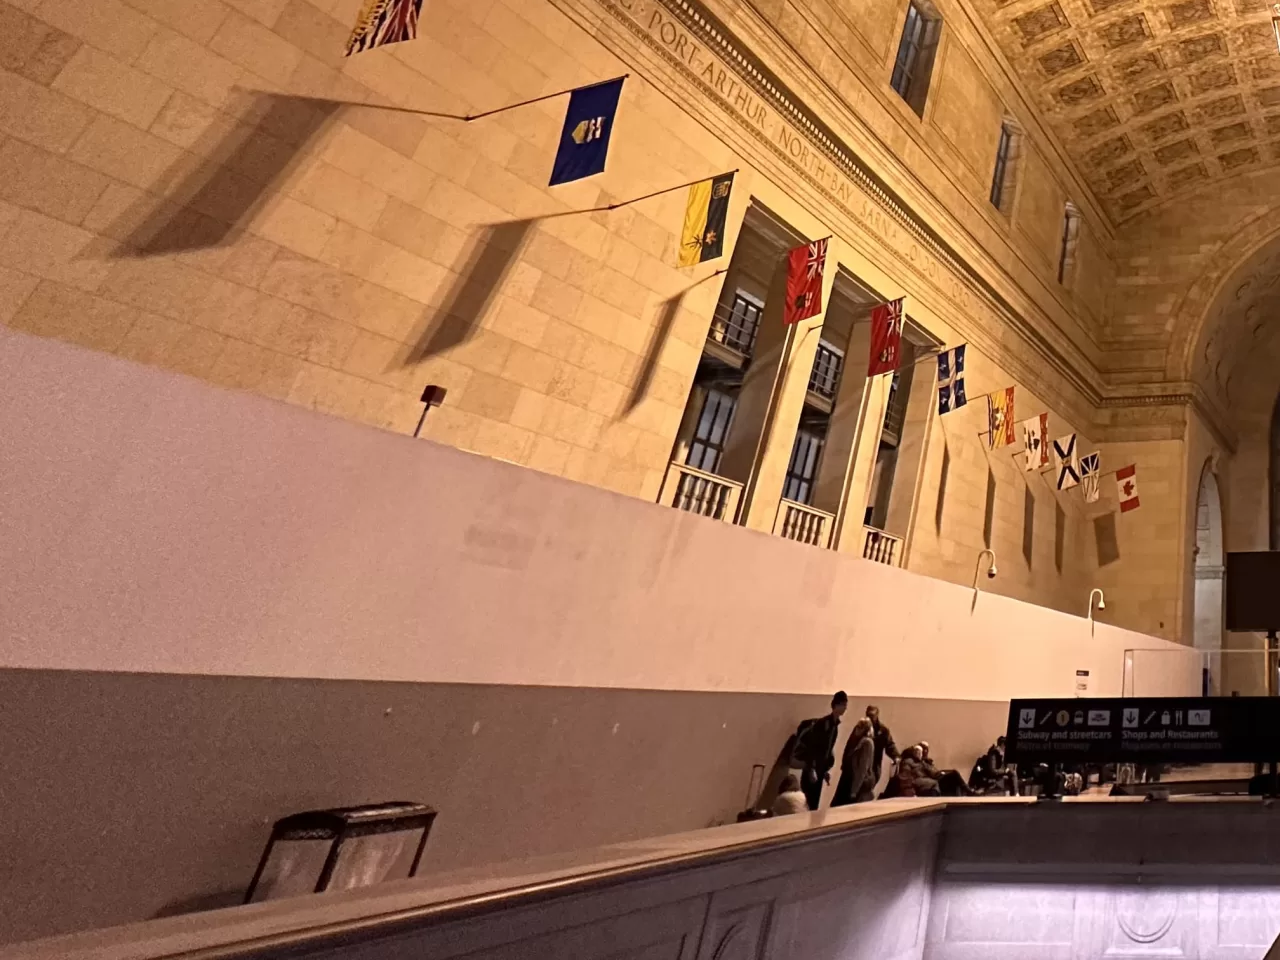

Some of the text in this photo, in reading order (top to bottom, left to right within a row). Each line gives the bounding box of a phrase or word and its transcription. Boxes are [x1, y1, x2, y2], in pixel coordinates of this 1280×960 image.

[648, 10, 768, 128] PORT-ARTHUR
[778, 126, 854, 204] NORTH-BAY
[859, 198, 898, 242] SARNA
[1016, 730, 1112, 742] Subway and streetcars
[1121, 728, 1219, 742] Shops and Restaurants
